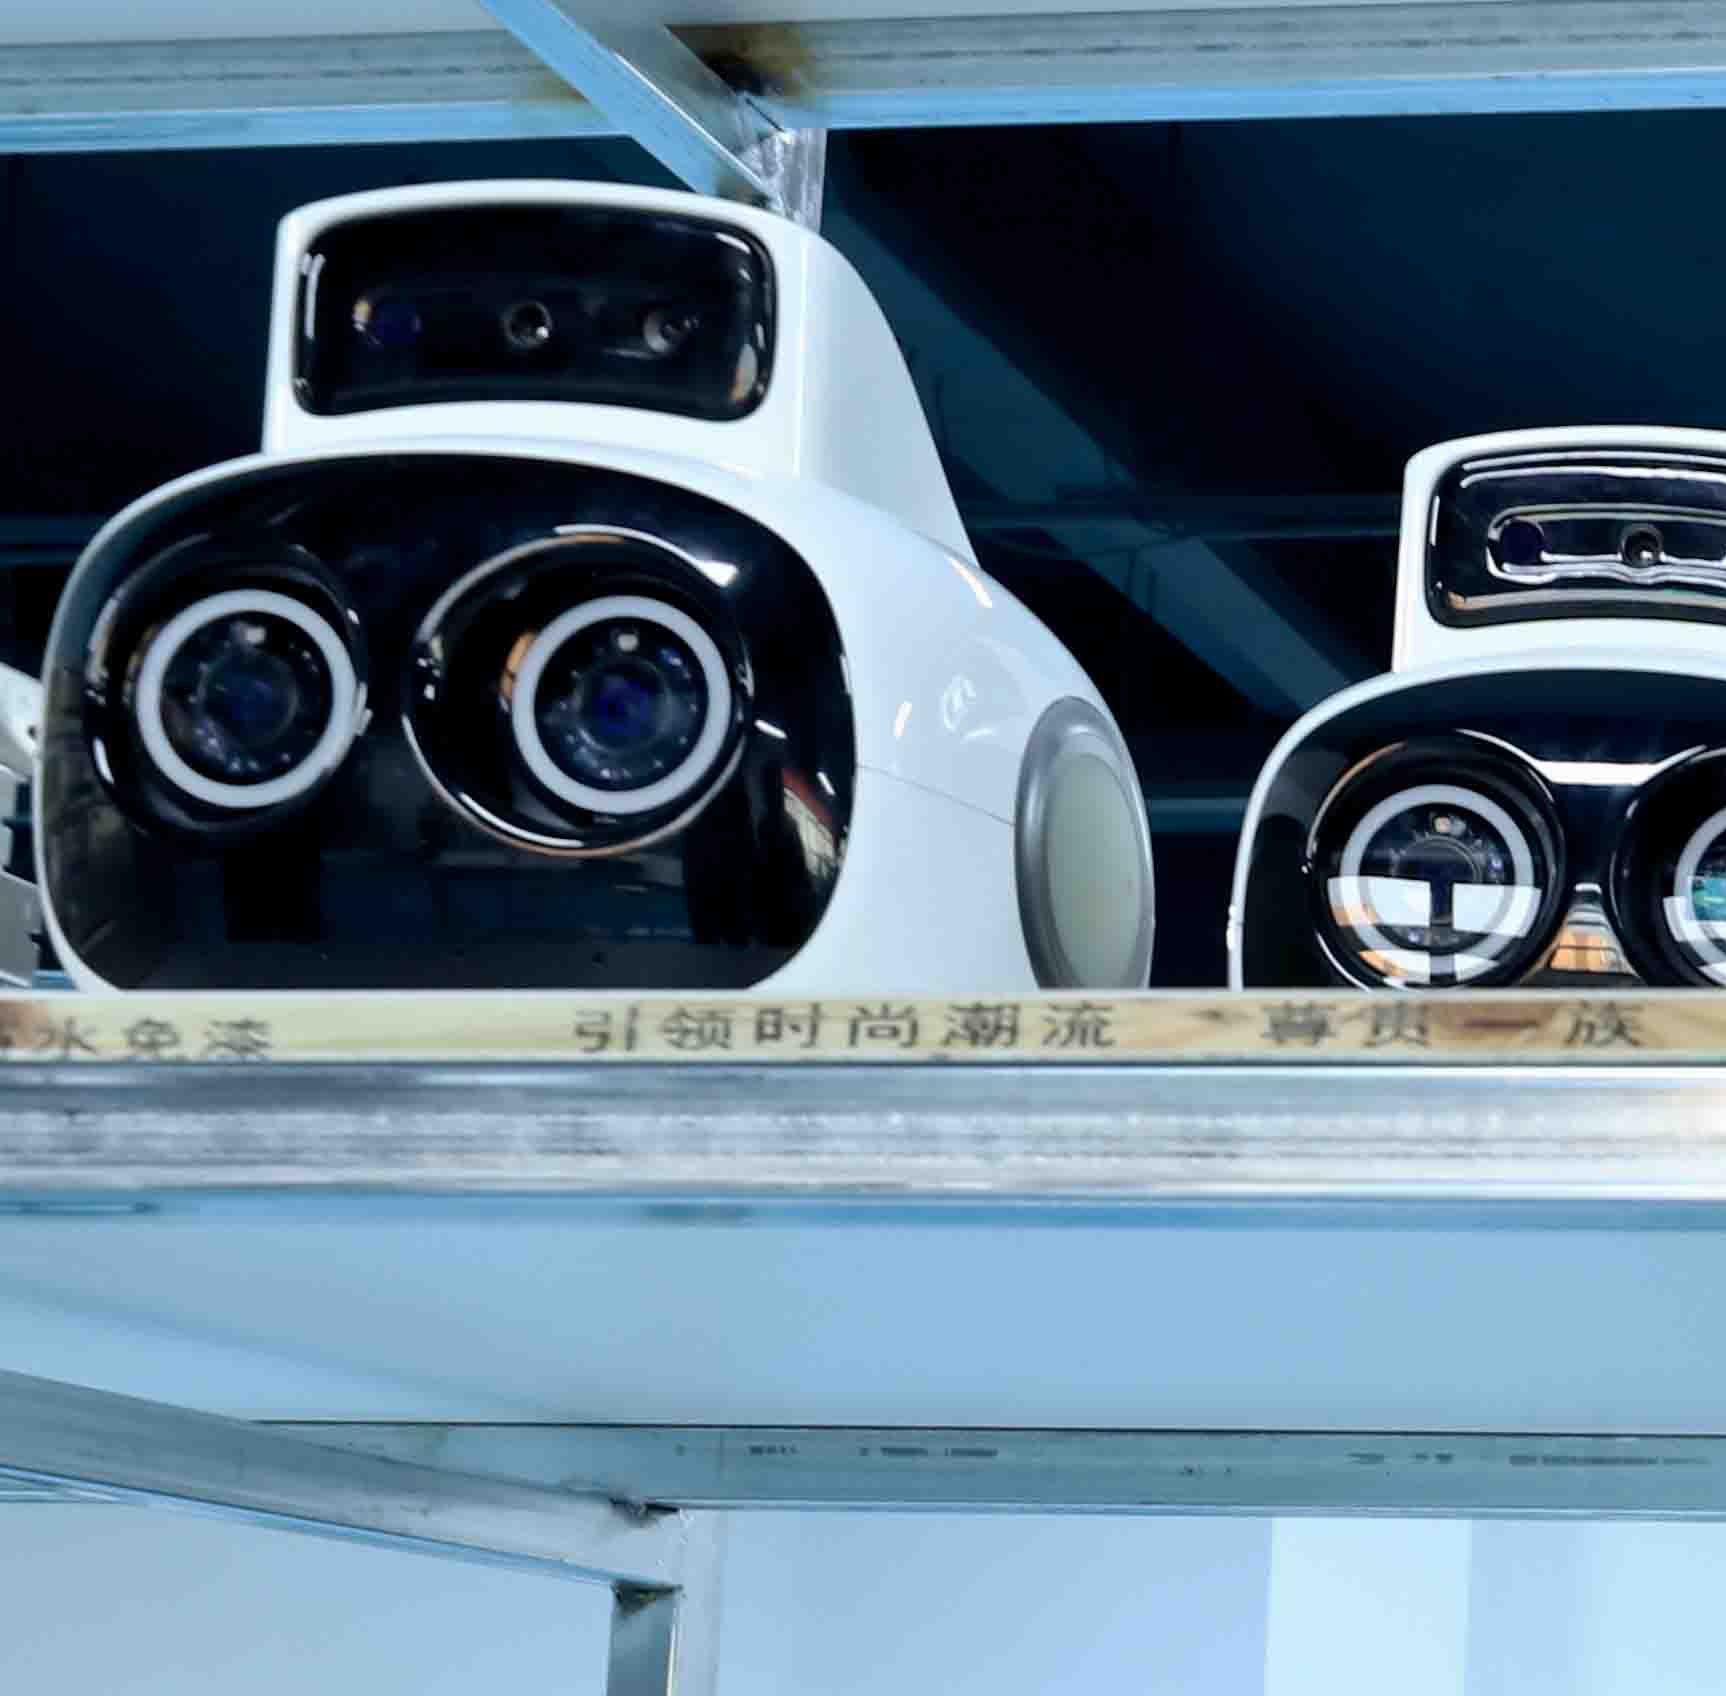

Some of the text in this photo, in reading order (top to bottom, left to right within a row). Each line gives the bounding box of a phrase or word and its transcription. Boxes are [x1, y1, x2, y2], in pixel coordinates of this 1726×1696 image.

[573, 1002, 1116, 1053] 引领时尚潮流
